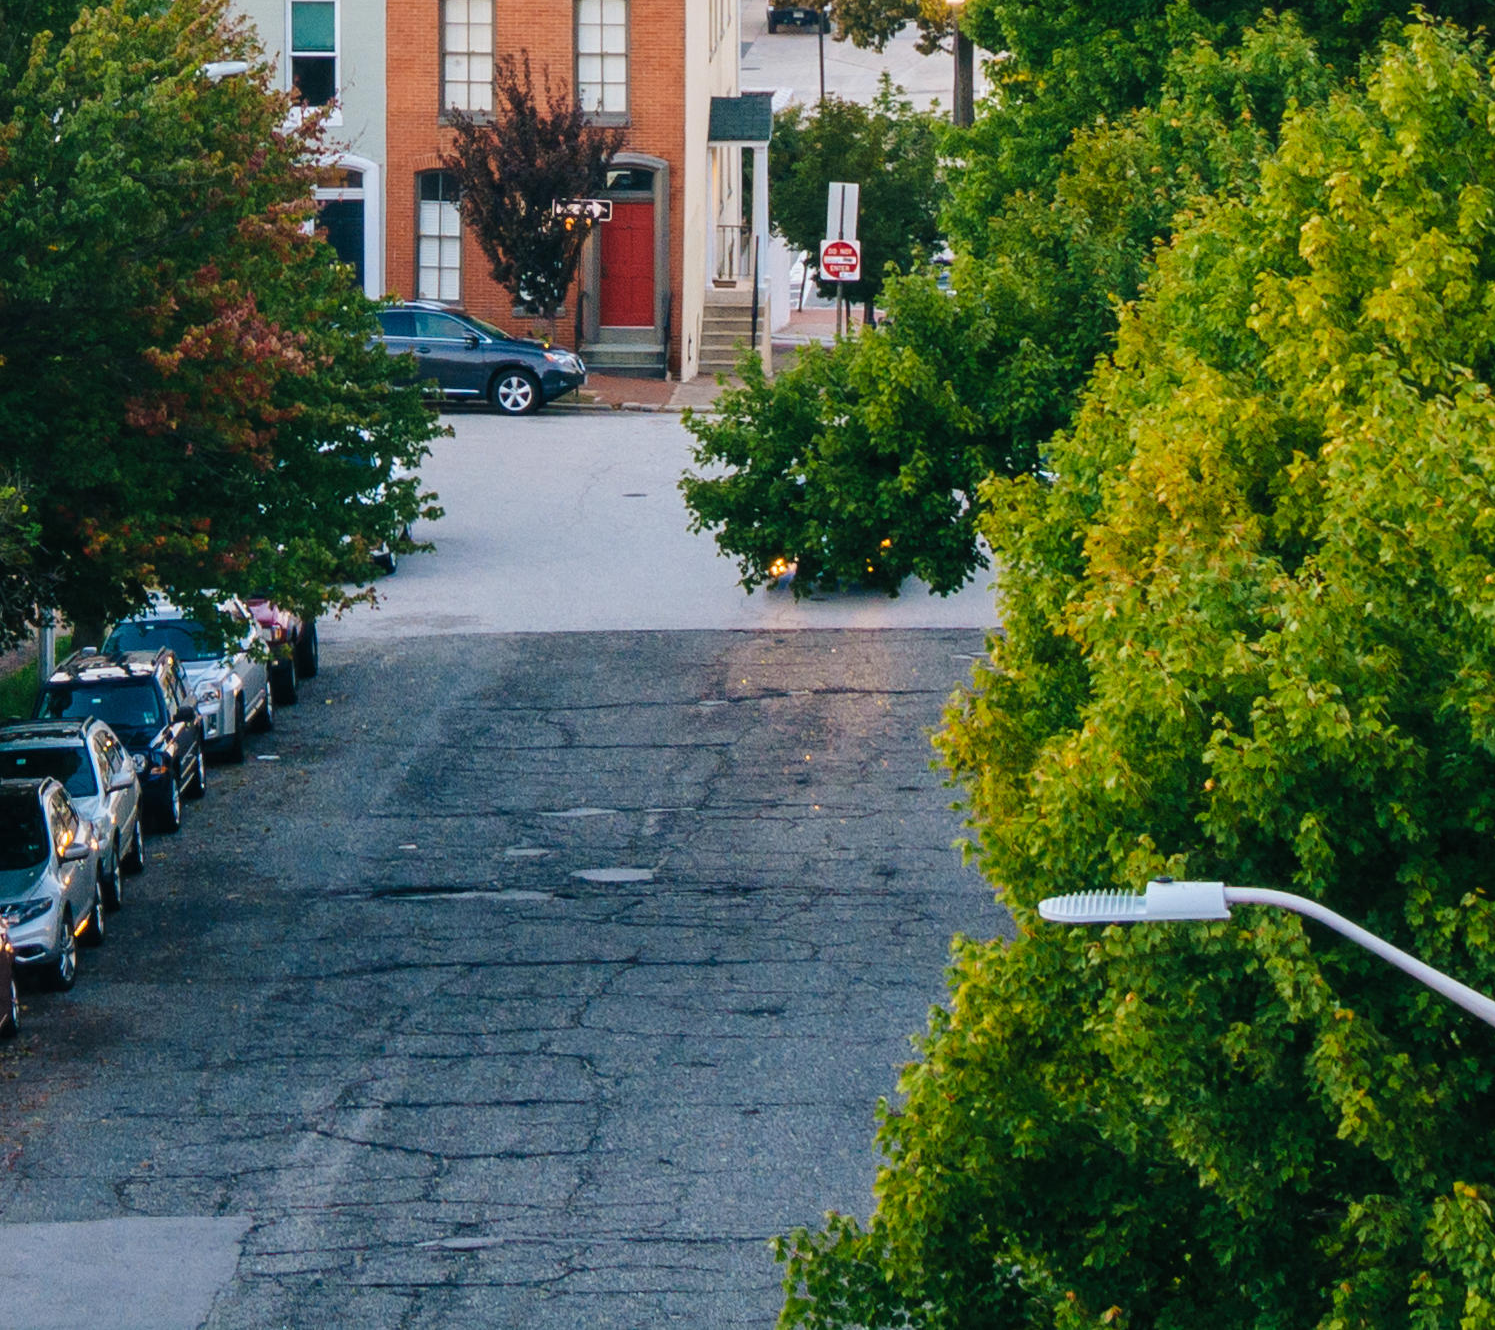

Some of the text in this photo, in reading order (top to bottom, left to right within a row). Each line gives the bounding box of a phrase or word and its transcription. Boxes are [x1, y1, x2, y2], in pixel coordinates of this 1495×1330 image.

[828, 247, 853, 255] DO NOT
[829, 264, 851, 272] ENTER
